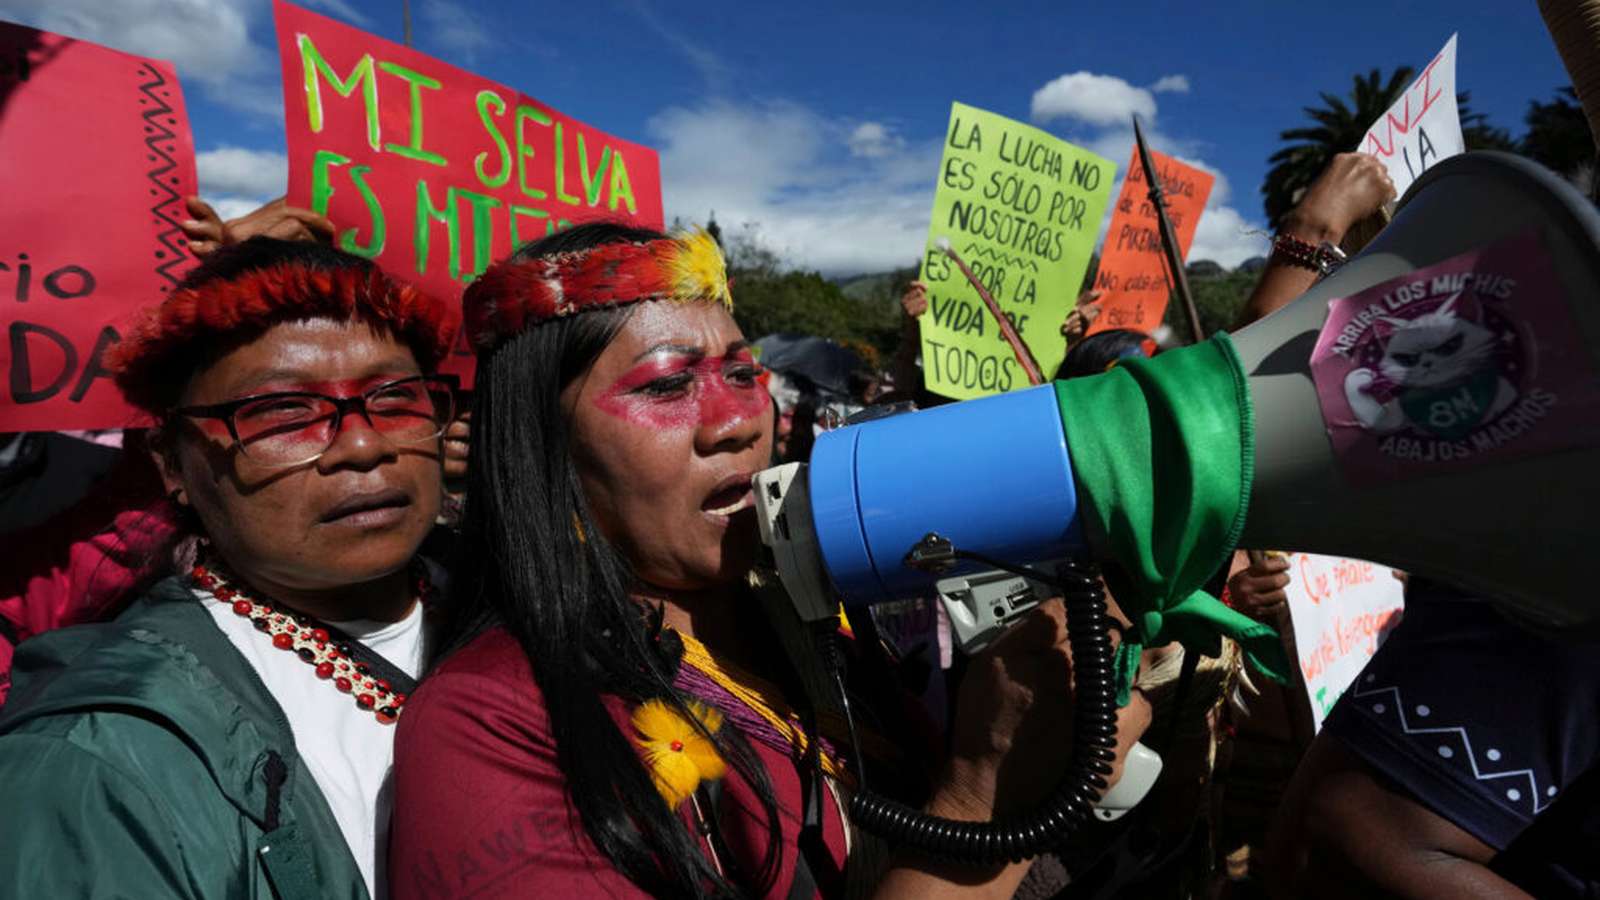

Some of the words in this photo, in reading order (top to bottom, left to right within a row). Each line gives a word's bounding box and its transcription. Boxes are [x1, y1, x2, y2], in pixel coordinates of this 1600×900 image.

[296, 33, 447, 167] MI
[475, 90, 637, 214] SELVA
[950, 117, 981, 152] LA
[1000, 131, 1062, 182] LUCHA
[1070, 159, 1100, 191] NO
[944, 156, 977, 191] ES
[984, 170, 1041, 215] SÓLO
[1048, 191, 1087, 231] POR
[0, 253, 96, 300] io
[1014, 275, 1036, 304] LA
[931, 294, 985, 337] VIDA
[1332, 303, 1388, 358] ARRIBA
[1383, 279, 1427, 309] LOS
[1430, 272, 1516, 299] MICHIS
[1429, 386, 1479, 428] 8M
[1471, 388, 1558, 454] MACHOS
